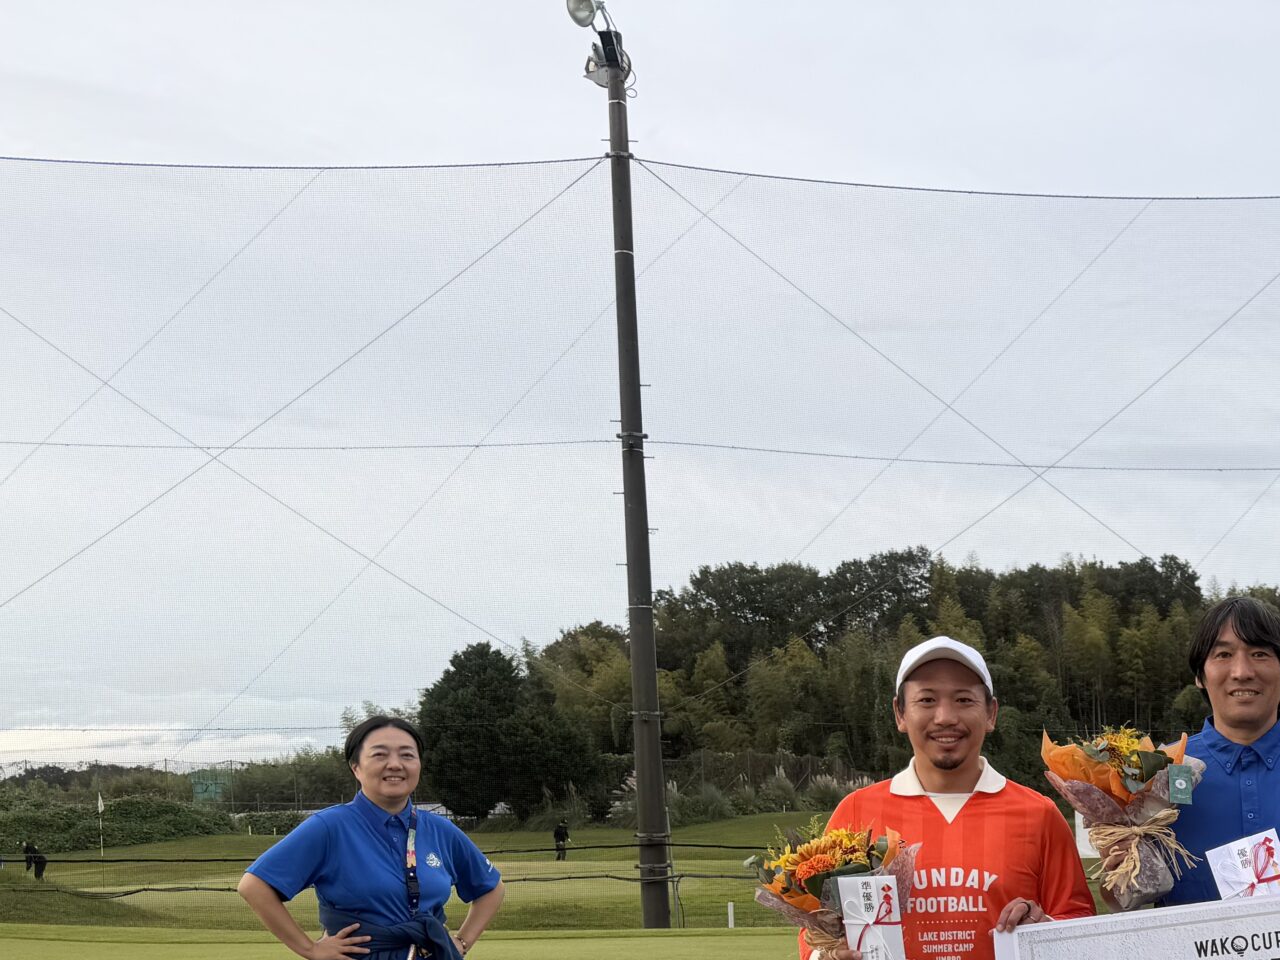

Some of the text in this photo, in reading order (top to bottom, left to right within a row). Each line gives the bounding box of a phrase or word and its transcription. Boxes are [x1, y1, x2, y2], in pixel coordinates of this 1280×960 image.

[913, 867, 999, 891] UNDAY
[861, 881, 874, 912] 準優勝
[907, 896, 987, 913] FOOTBALL
[918, 930, 976, 941] LAKE DISTRICT
[922, 943, 974, 953] SUMMER CAMP
